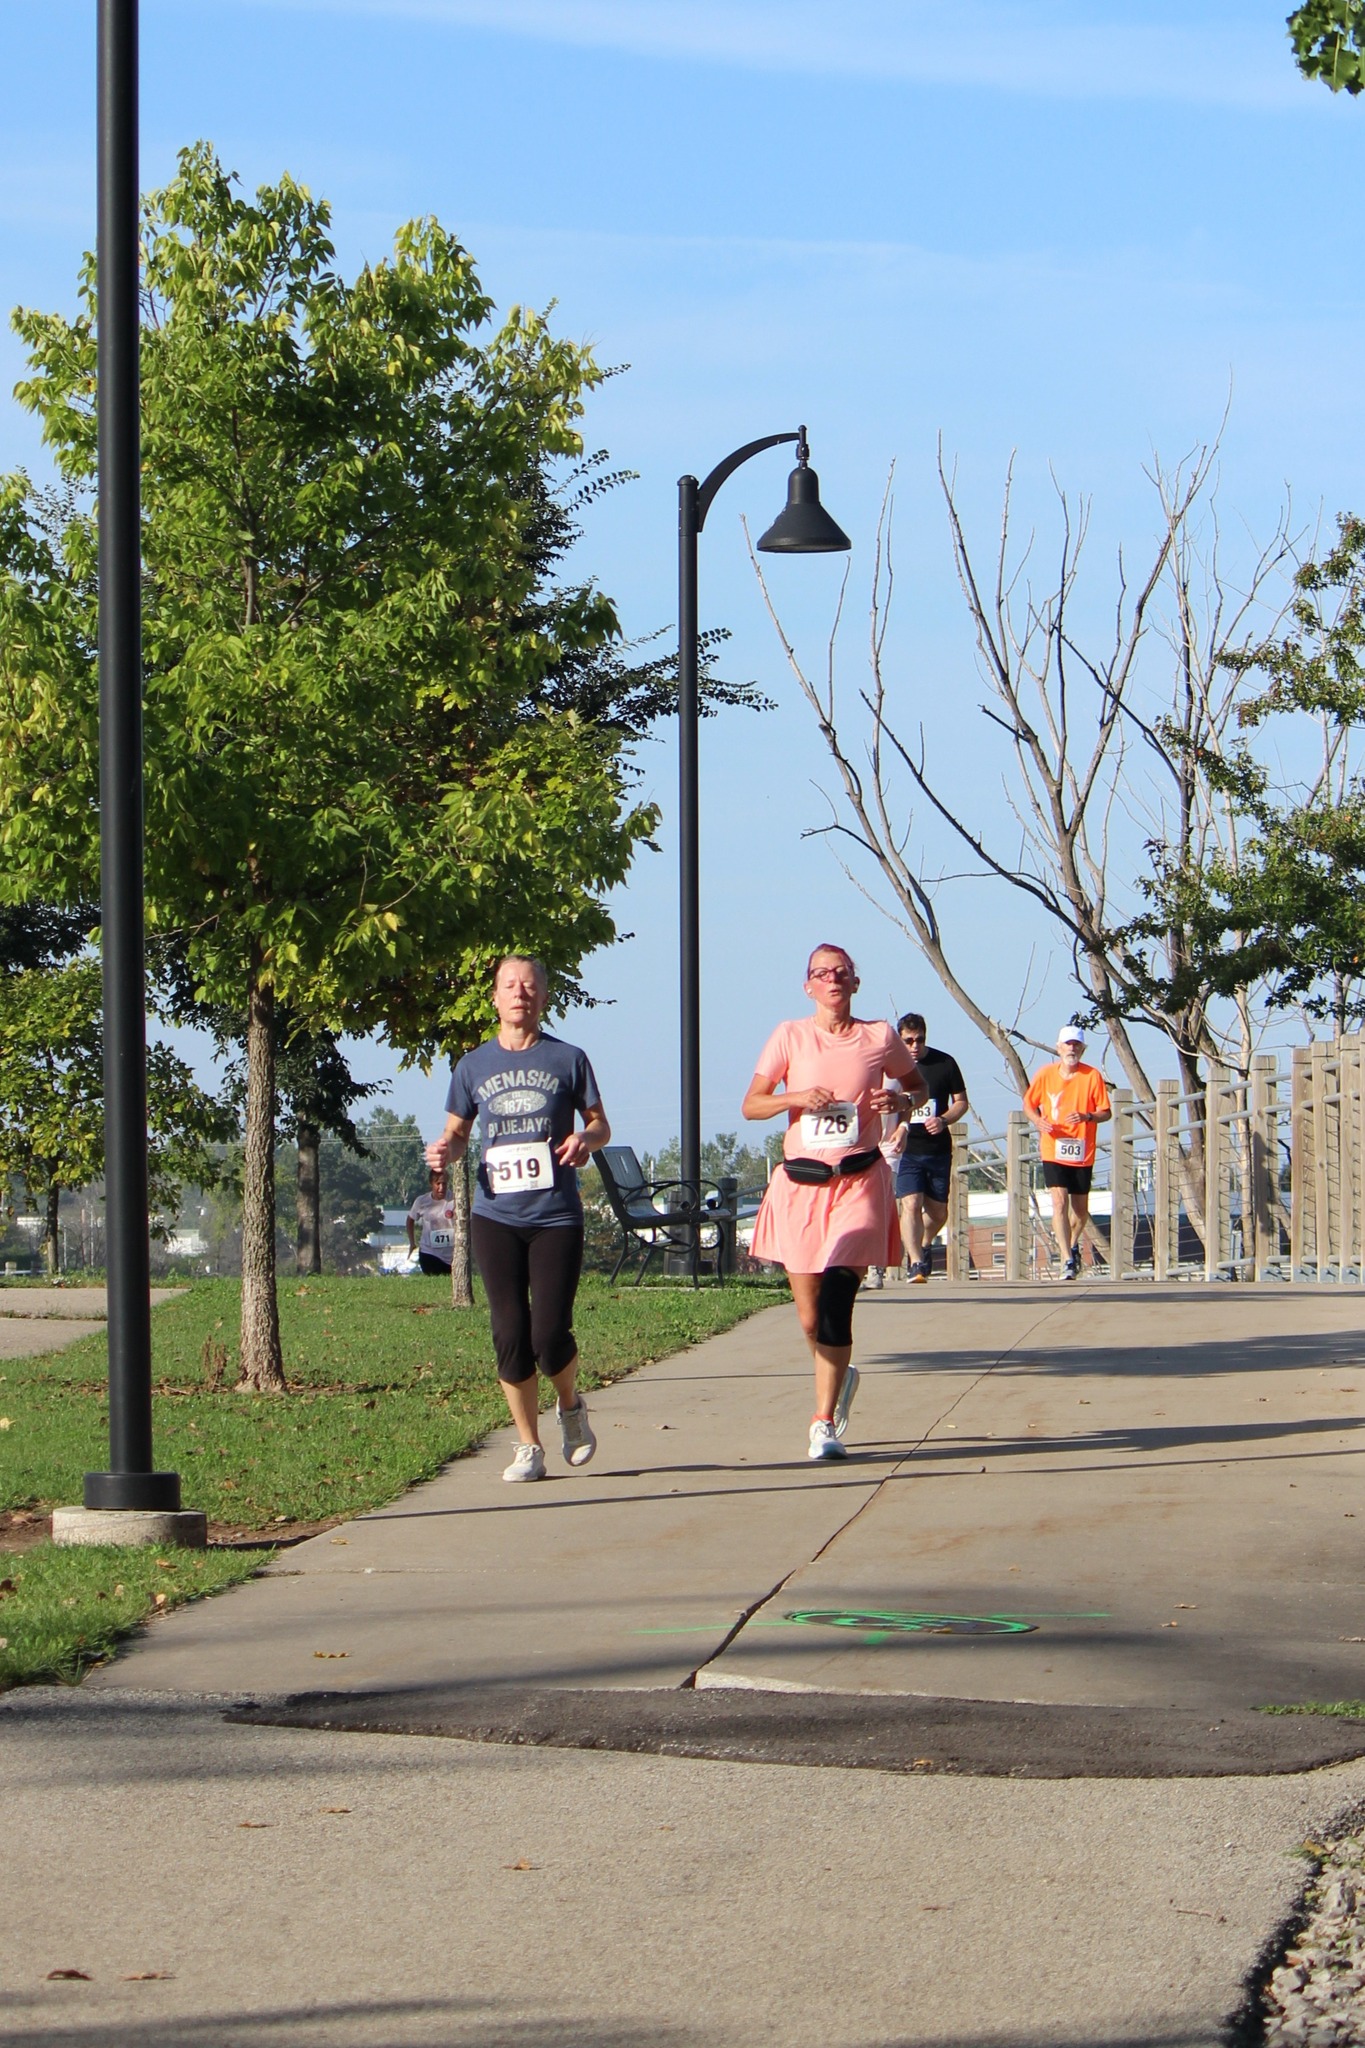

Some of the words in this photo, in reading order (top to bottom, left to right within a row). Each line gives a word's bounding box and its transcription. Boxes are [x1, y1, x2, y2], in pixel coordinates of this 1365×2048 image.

[478, 1069, 560, 1101] MENASHA
[503, 1098, 532, 1114] 1875
[811, 1114, 848, 1136] 726
[1060, 1144, 1081, 1156] 503
[498, 1157, 541, 1181] 519
[434, 1234, 450, 1244] 471
